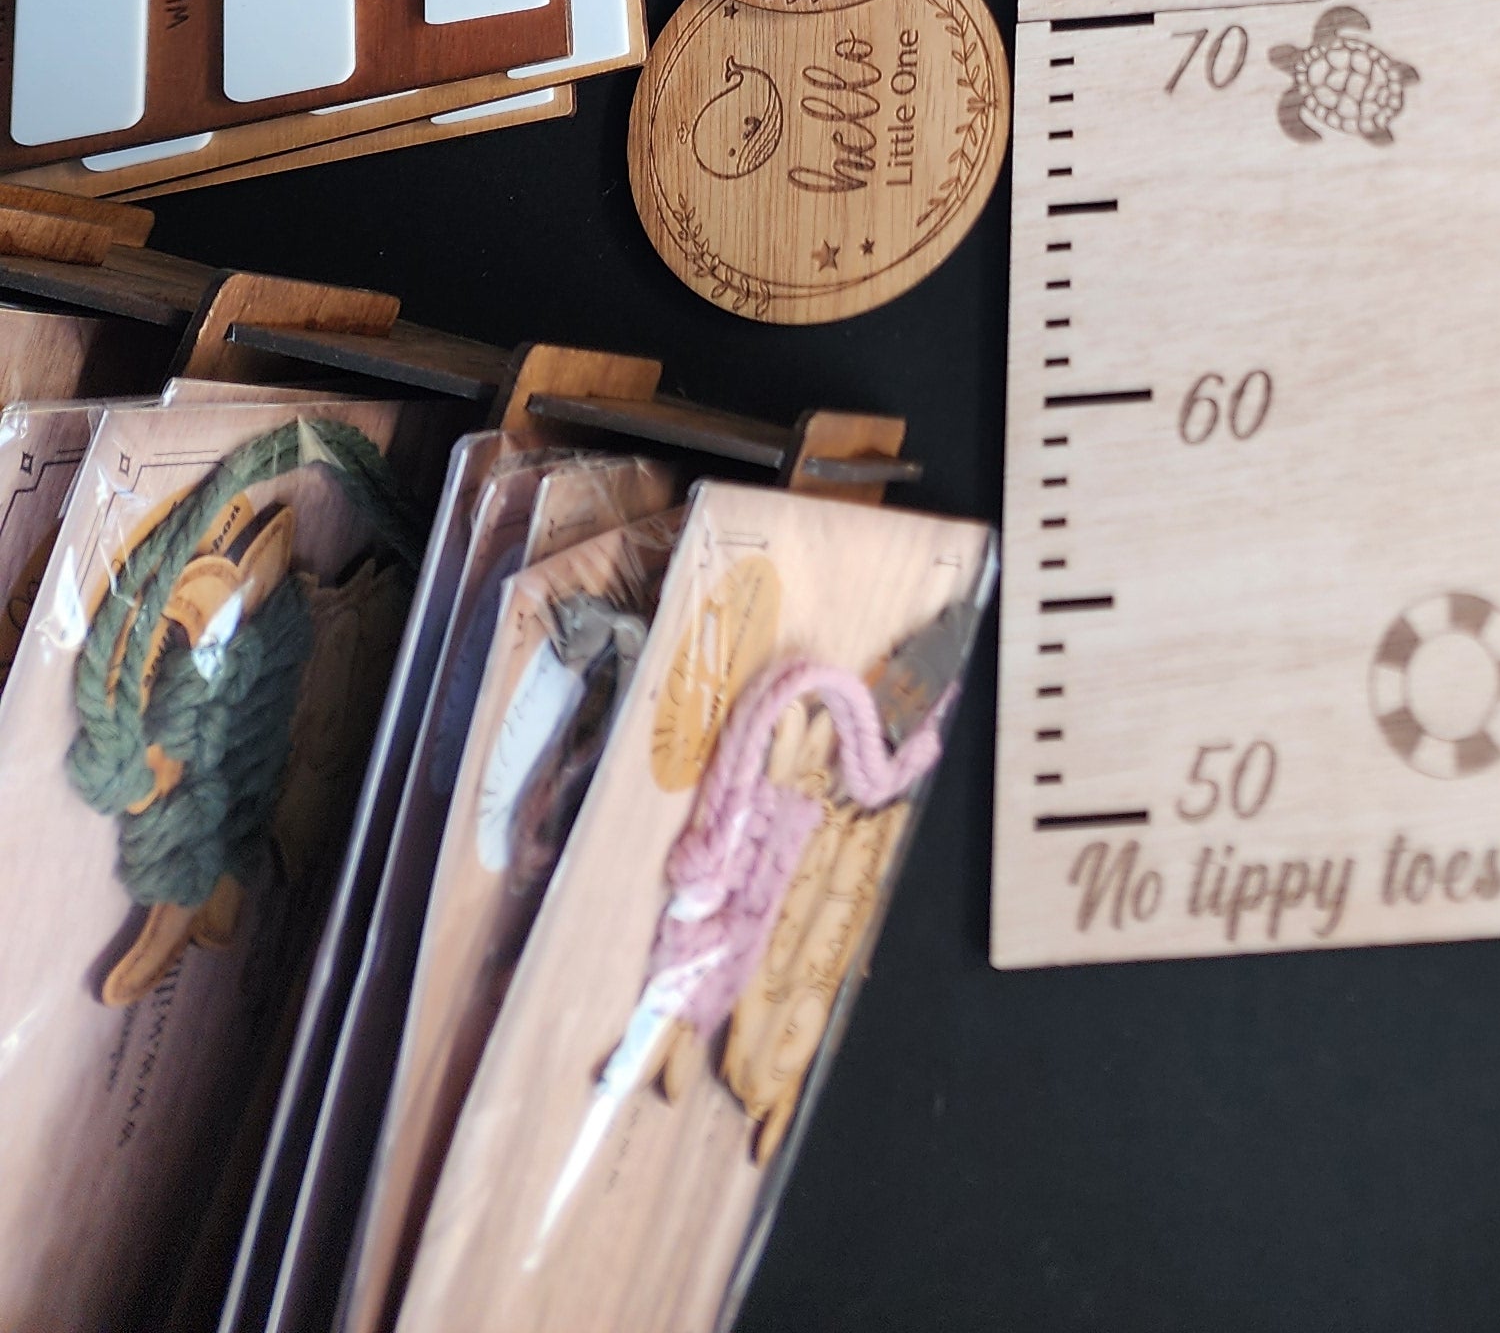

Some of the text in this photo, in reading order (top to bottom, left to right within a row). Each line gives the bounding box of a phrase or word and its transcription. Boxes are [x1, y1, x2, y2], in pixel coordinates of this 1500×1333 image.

[1164, 25, 1248, 96] 70
[788, 30, 882, 194] hello
[886, 29, 919, 186] Little One
[1179, 370, 1272, 444] 60
[1175, 740, 1277, 822] 50
[1067, 840, 1163, 931] No
[1186, 844, 1355, 941] tippy
